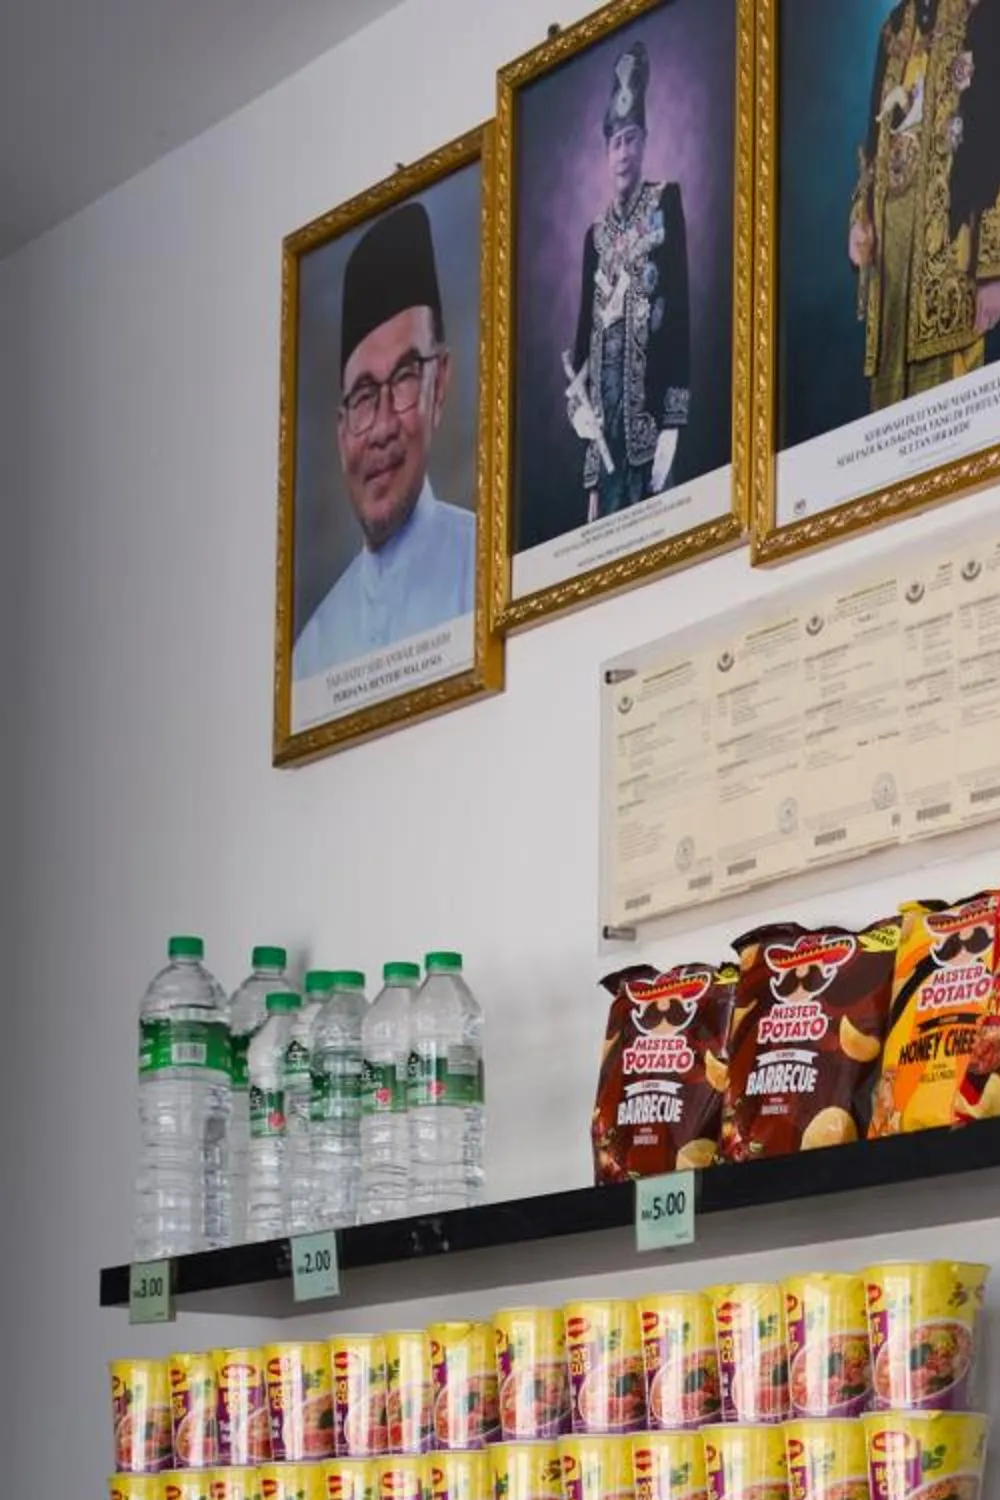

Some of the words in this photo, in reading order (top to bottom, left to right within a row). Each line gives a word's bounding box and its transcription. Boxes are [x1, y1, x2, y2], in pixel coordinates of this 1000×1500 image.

[932, 966, 984, 986] MISTER
[920, 978, 992, 1009] POTATO
[772, 1005, 818, 1019] MISTER
[760, 1017, 826, 1041] POTATO
[634, 1038, 684, 1051] MISTER
[900, 1033, 940, 1066] HONEY
[625, 1048, 694, 1070] POTATO
[746, 1063, 819, 1096] BARBECUE
[617, 1095, 684, 1126] BARBECUE
